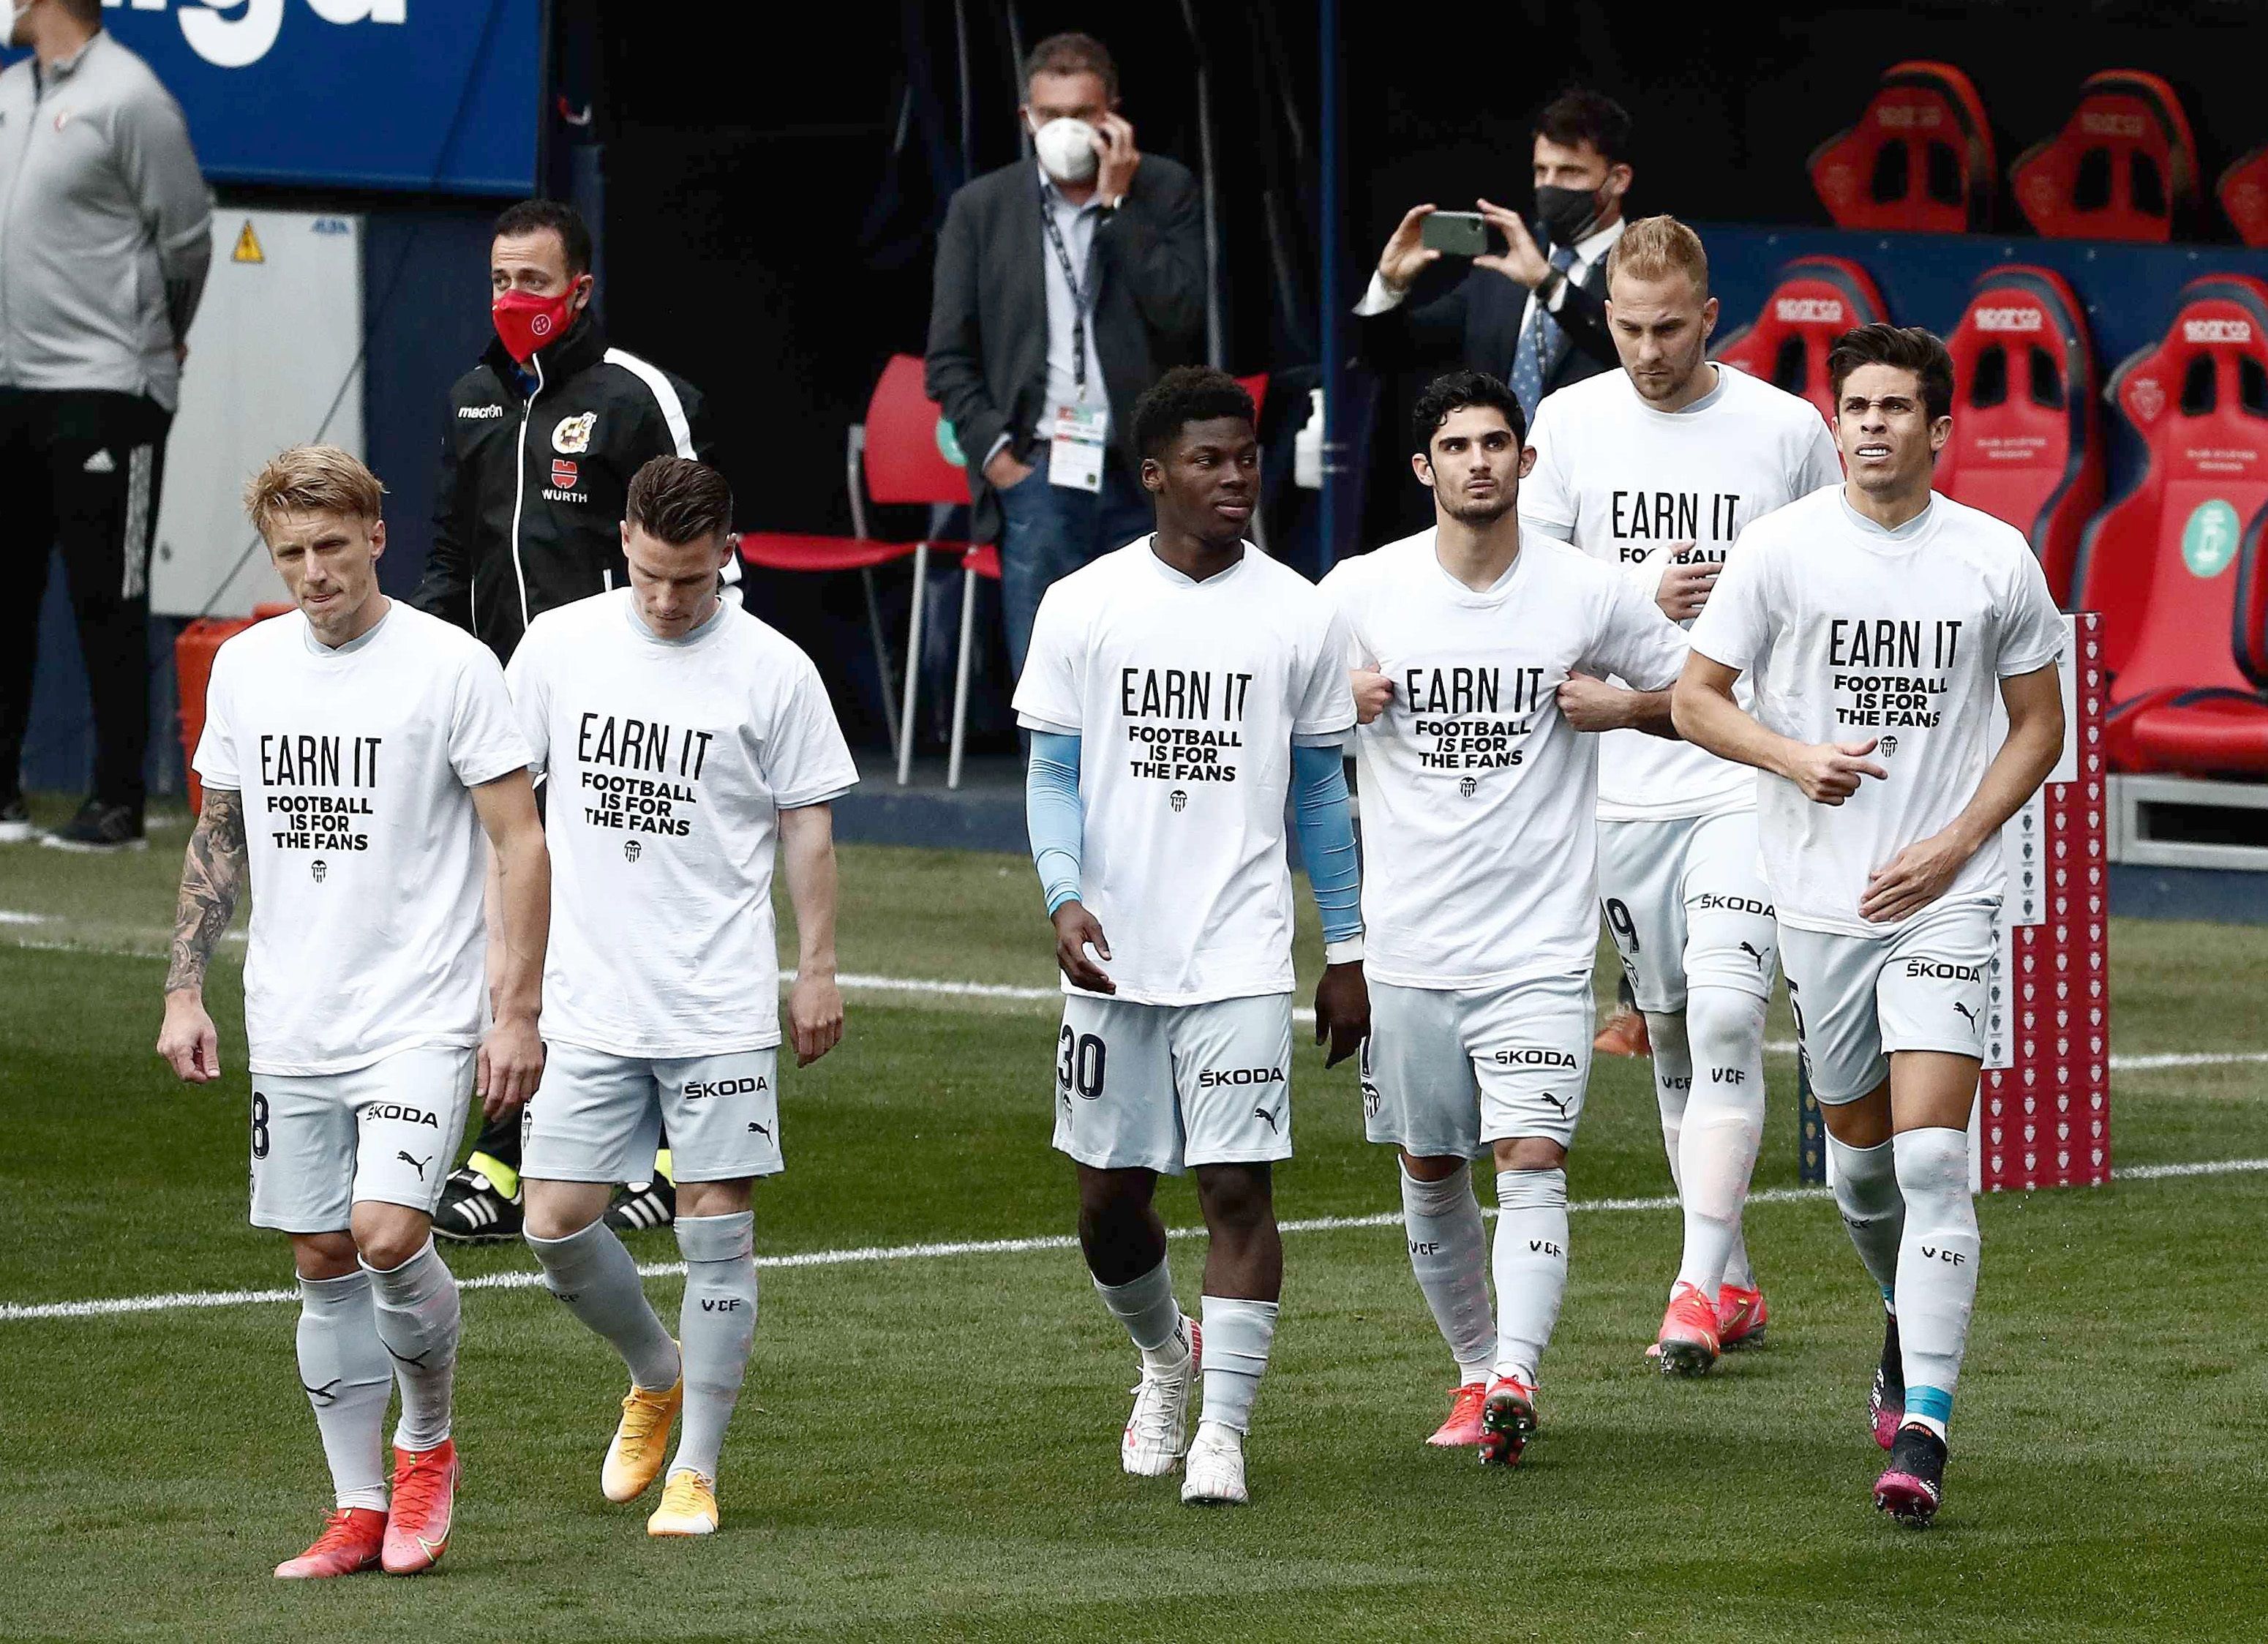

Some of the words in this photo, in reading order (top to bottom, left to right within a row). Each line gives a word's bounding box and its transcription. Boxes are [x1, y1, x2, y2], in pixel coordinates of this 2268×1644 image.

[458, 404, 503, 418] macron
[1612, 491, 1698, 539] EARN
[1713, 494, 1740, 541] IT
[1829, 619, 1920, 668] EARN
[1934, 620, 1962, 669] IT
[1407, 667, 1499, 713] EARN
[1514, 668, 1544, 713] IT
[1834, 674, 1948, 694] FOOTBALL
[1122, 668, 1211, 721] EARN
[1224, 673, 1253, 721] IT
[1855, 693, 1877, 710] IS
[1882, 694, 1928, 710] FOR
[1836, 707, 1880, 727] THE
[1885, 710, 1942, 728] FANS
[1129, 725, 1242, 747] FOOTBALL
[1416, 719, 1531, 737] FOOTBALL
[578, 712, 669, 773] EARN
[680, 729, 713, 781] IT
[1149, 744, 1168, 762] IS
[1172, 746, 1217, 764] FOR
[1436, 737, 1457, 753] IS
[1460, 737, 1507, 753] FOR
[260, 735, 340, 787] EARN
[354, 737, 382, 788] IT
[1418, 751, 1460, 768] THE
[1465, 749, 1523, 768] FANS
[1130, 761, 1171, 780] THE
[1175, 764, 1236, 782] FANS
[582, 771, 696, 803] FOOTBALL
[267, 795, 373, 814] FOOTBALL
[601, 792, 621, 810] IS
[625, 796, 672, 817] FOR
[289, 814, 307, 831] IS
[311, 814, 349, 833] FOR
[585, 807, 624, 829] THE
[628, 814, 691, 836] FANS
[272, 832, 310, 849] THE
[315, 833, 368, 851] FANS
[1907, 960, 1980, 983] ŠKODA
[1058, 1024, 1106, 1100] 30
[1199, 1067, 1285, 1087] ŠKODA
[1712, 1067, 1744, 1084] VCF
[685, 1076, 768, 1099] ŠKODA
[252, 1092, 269, 1160] 8
[1409, 1240, 1439, 1255] VCF
[1530, 1240, 1561, 1257] VCF
[1922, 1247, 1965, 1266] VCF
[702, 1299, 740, 1311] VCF
